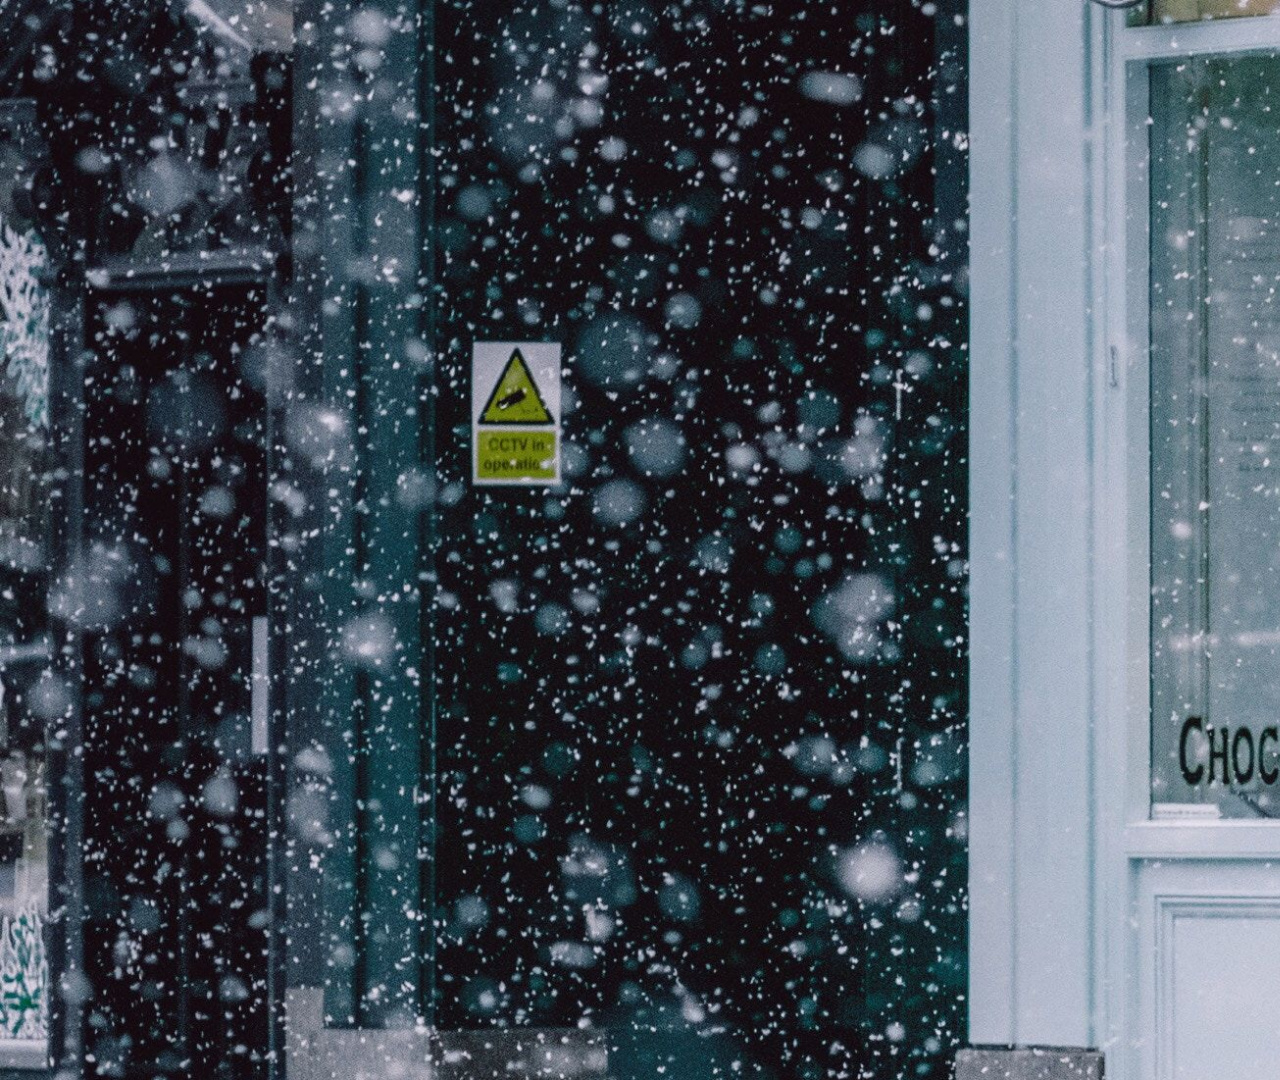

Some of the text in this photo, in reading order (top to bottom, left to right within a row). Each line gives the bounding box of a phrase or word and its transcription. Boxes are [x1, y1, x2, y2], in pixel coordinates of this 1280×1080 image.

[488, 437, 545, 452] CCTV in
[484, 457, 550, 474] operatio
